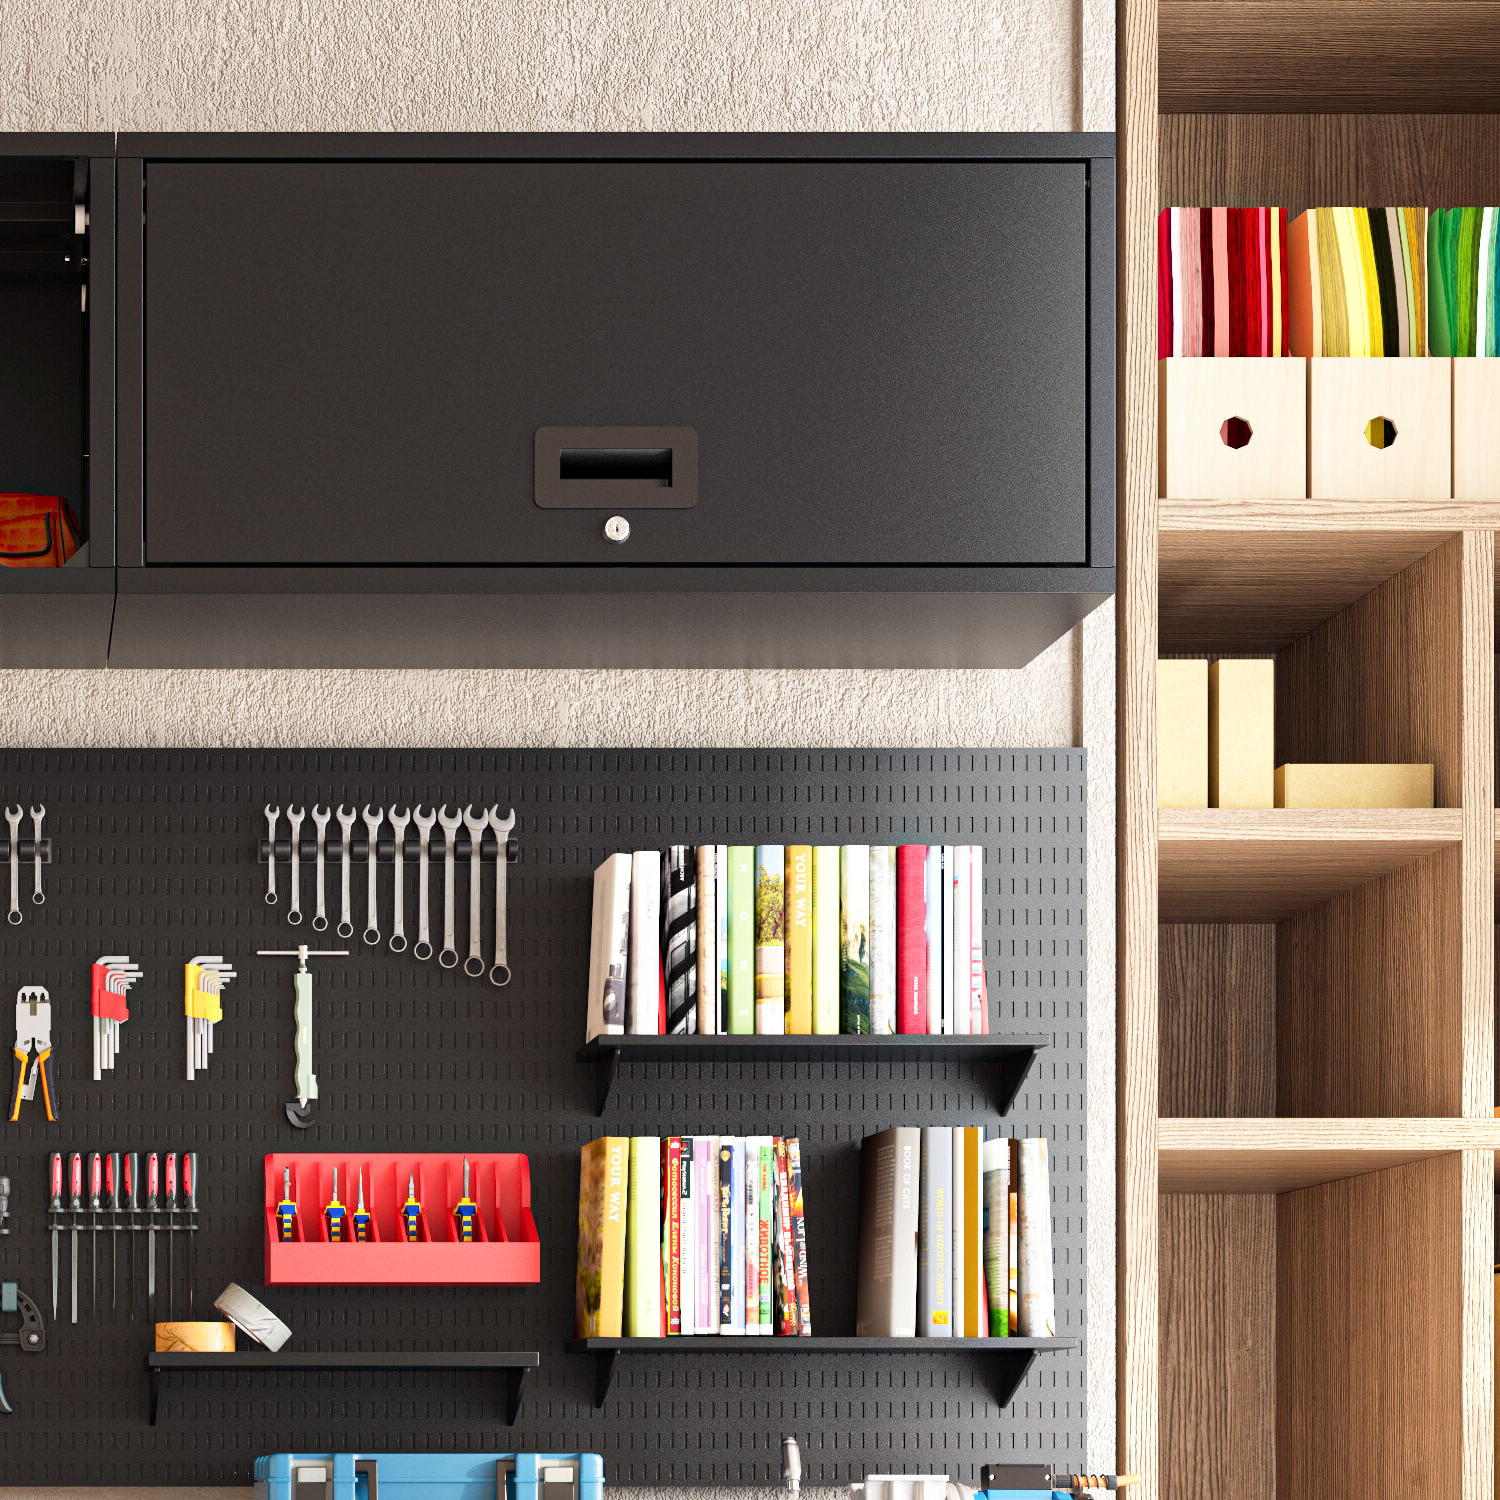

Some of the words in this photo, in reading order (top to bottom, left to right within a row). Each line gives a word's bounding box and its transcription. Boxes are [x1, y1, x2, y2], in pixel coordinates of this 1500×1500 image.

[796, 853, 806, 894] YOUR
[796, 898, 806, 927] WAY
[610, 1145, 622, 1187] YOUR
[903, 1146, 912, 1170] BOOK
[903, 1173, 911, 1185] OF
[609, 1192, 620, 1223] WAY
[902, 1188, 911, 1210] CATS
[796, 1217, 806, 1241] LION
[759, 1220, 769, 1285] ЖИВОТНОЕ
